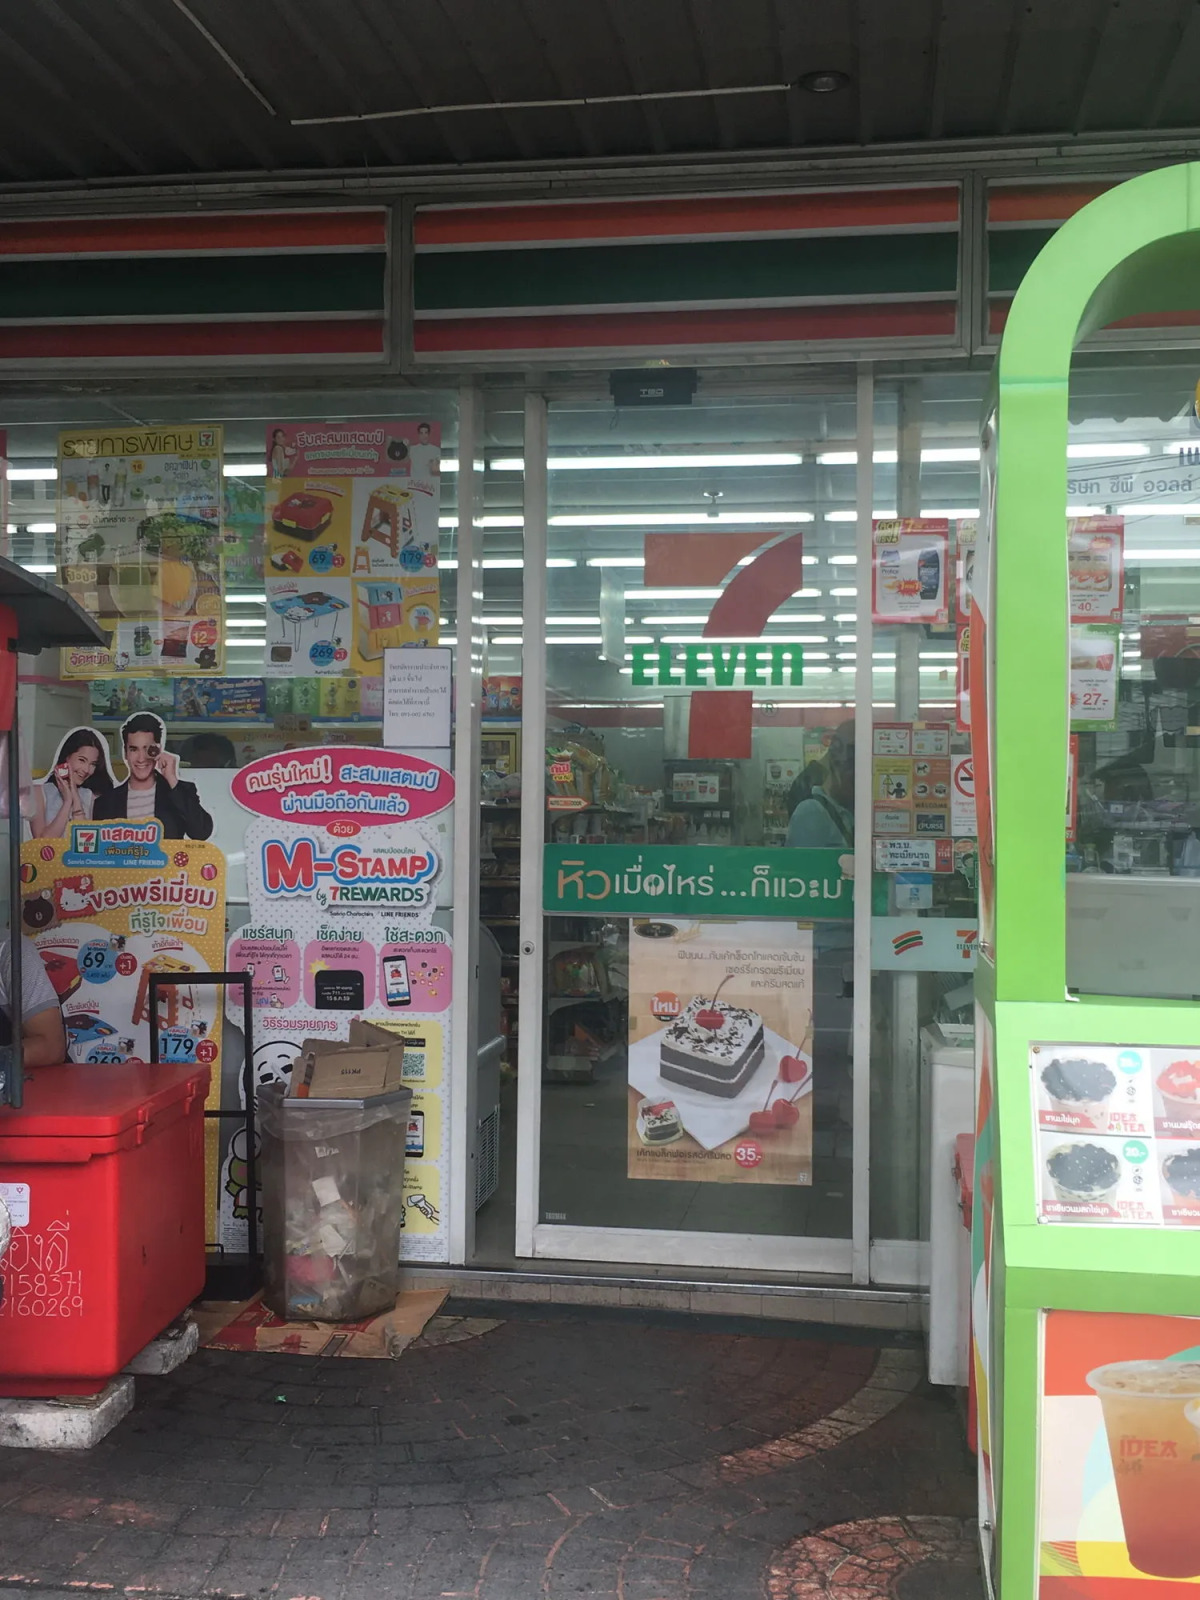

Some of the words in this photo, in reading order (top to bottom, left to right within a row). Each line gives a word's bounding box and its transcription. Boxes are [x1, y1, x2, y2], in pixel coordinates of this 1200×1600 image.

[249, 757, 330, 790] คนรุ่นใหม่!
[341, 766, 438, 789] สะสมแสตมป์
[283, 792, 407, 814] ผ่านมือถือกันแล้ว
[102, 826, 156, 842] แสตมป์
[334, 824, 354, 834] ด้วย
[90, 873, 216, 908] ของพรีเมี่ยม
[316, 889, 327, 905] by
[131, 906, 205, 933] ที่รู้ใจเพื่อน
[242, 924, 293, 945] แชร์สนุก
[317, 924, 362, 941] เช็คง่าย
[384, 926, 444, 943] ใช้สะดวก
[83, 952, 105, 968] 69
[120, 960, 132, 969] +1
[652, 996, 679, 1013] ใหม่
[161, 1038, 194, 1054] 179
[200, 1048, 213, 1057] +1
[1123, 1123, 1145, 1132] TEA
[736, 1148, 762, 1162] 35.-
[1120, 1439, 1178, 1458] IDEA
